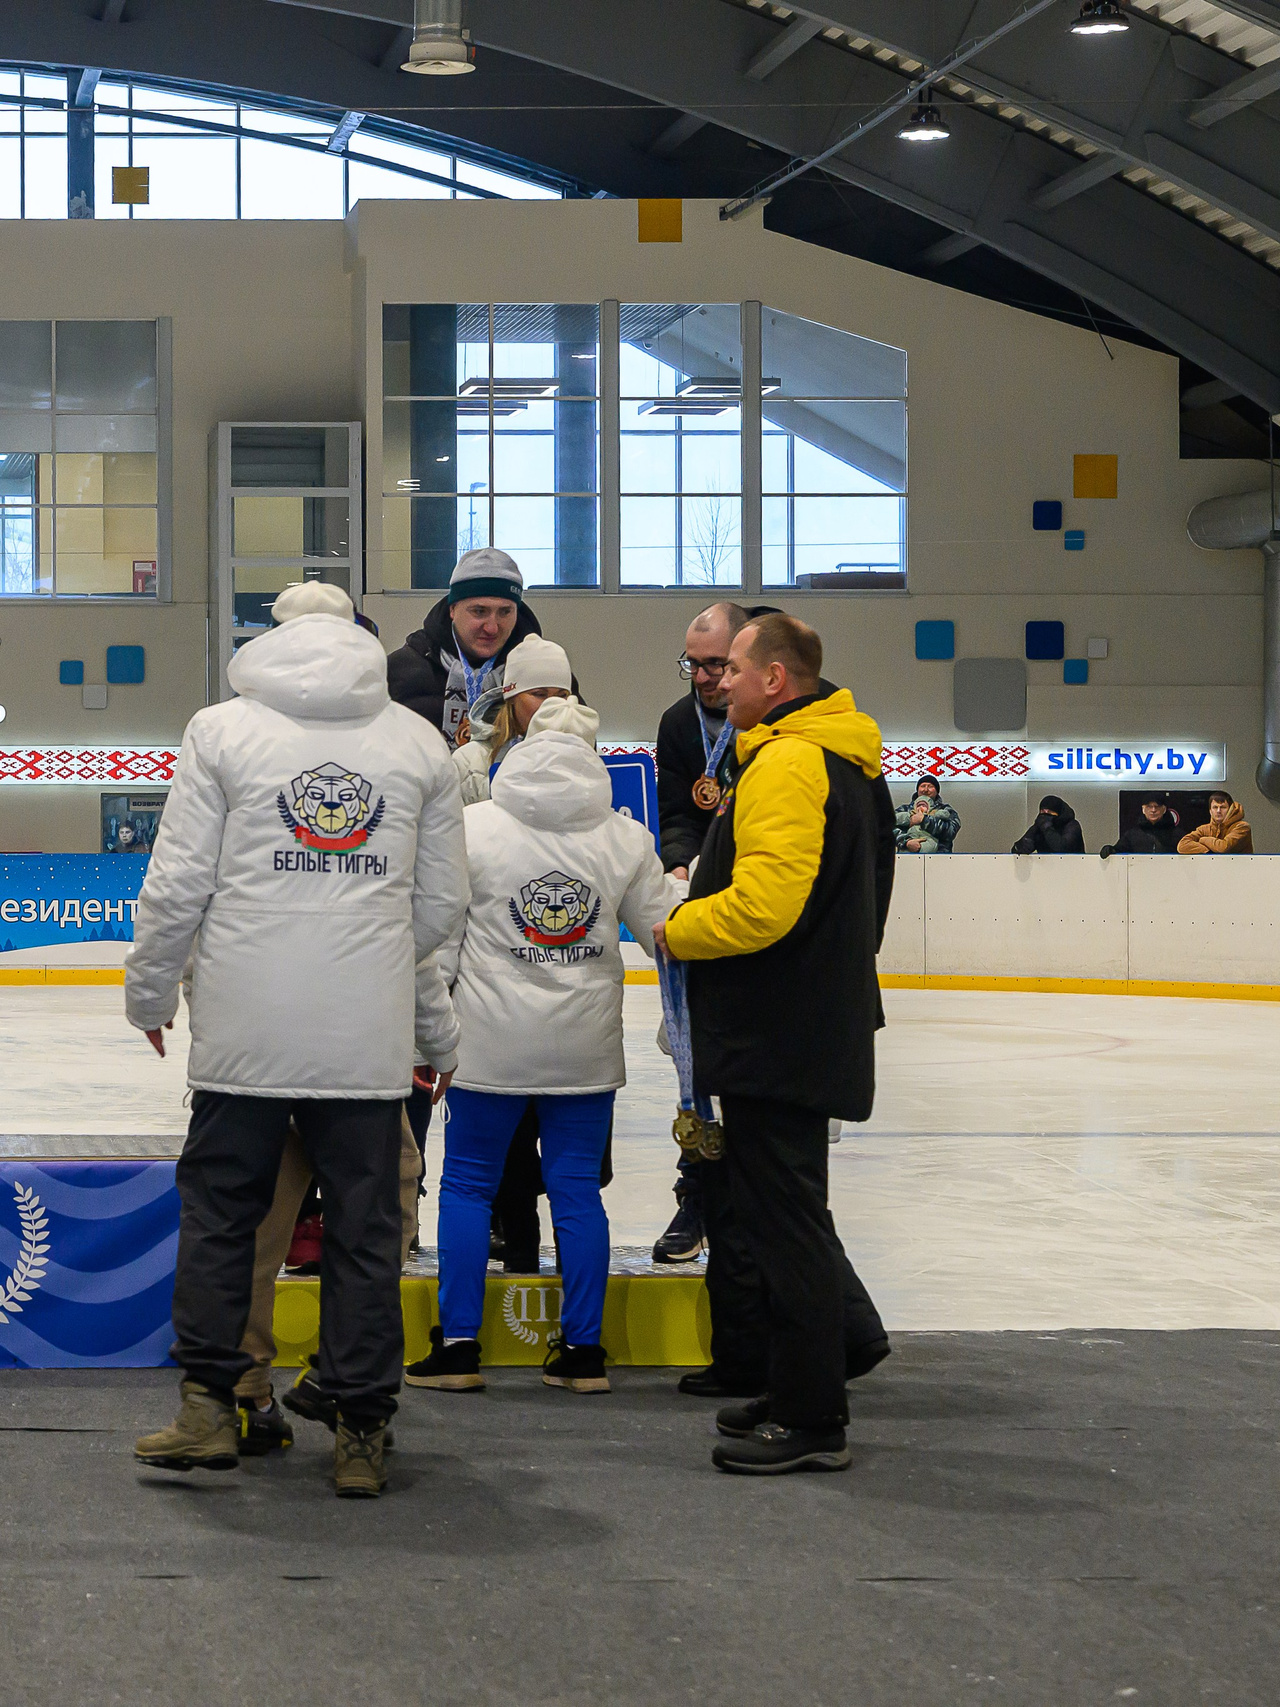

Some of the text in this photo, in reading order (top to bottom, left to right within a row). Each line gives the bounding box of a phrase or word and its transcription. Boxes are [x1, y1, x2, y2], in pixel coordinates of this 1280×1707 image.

[1048, 748, 1208, 775] silichy.by
[274, 850, 388, 876] БЕЛЫЕ ТИГРЫ
[510, 945, 604, 963] БЕЛЫЕ ТИГРЫ
